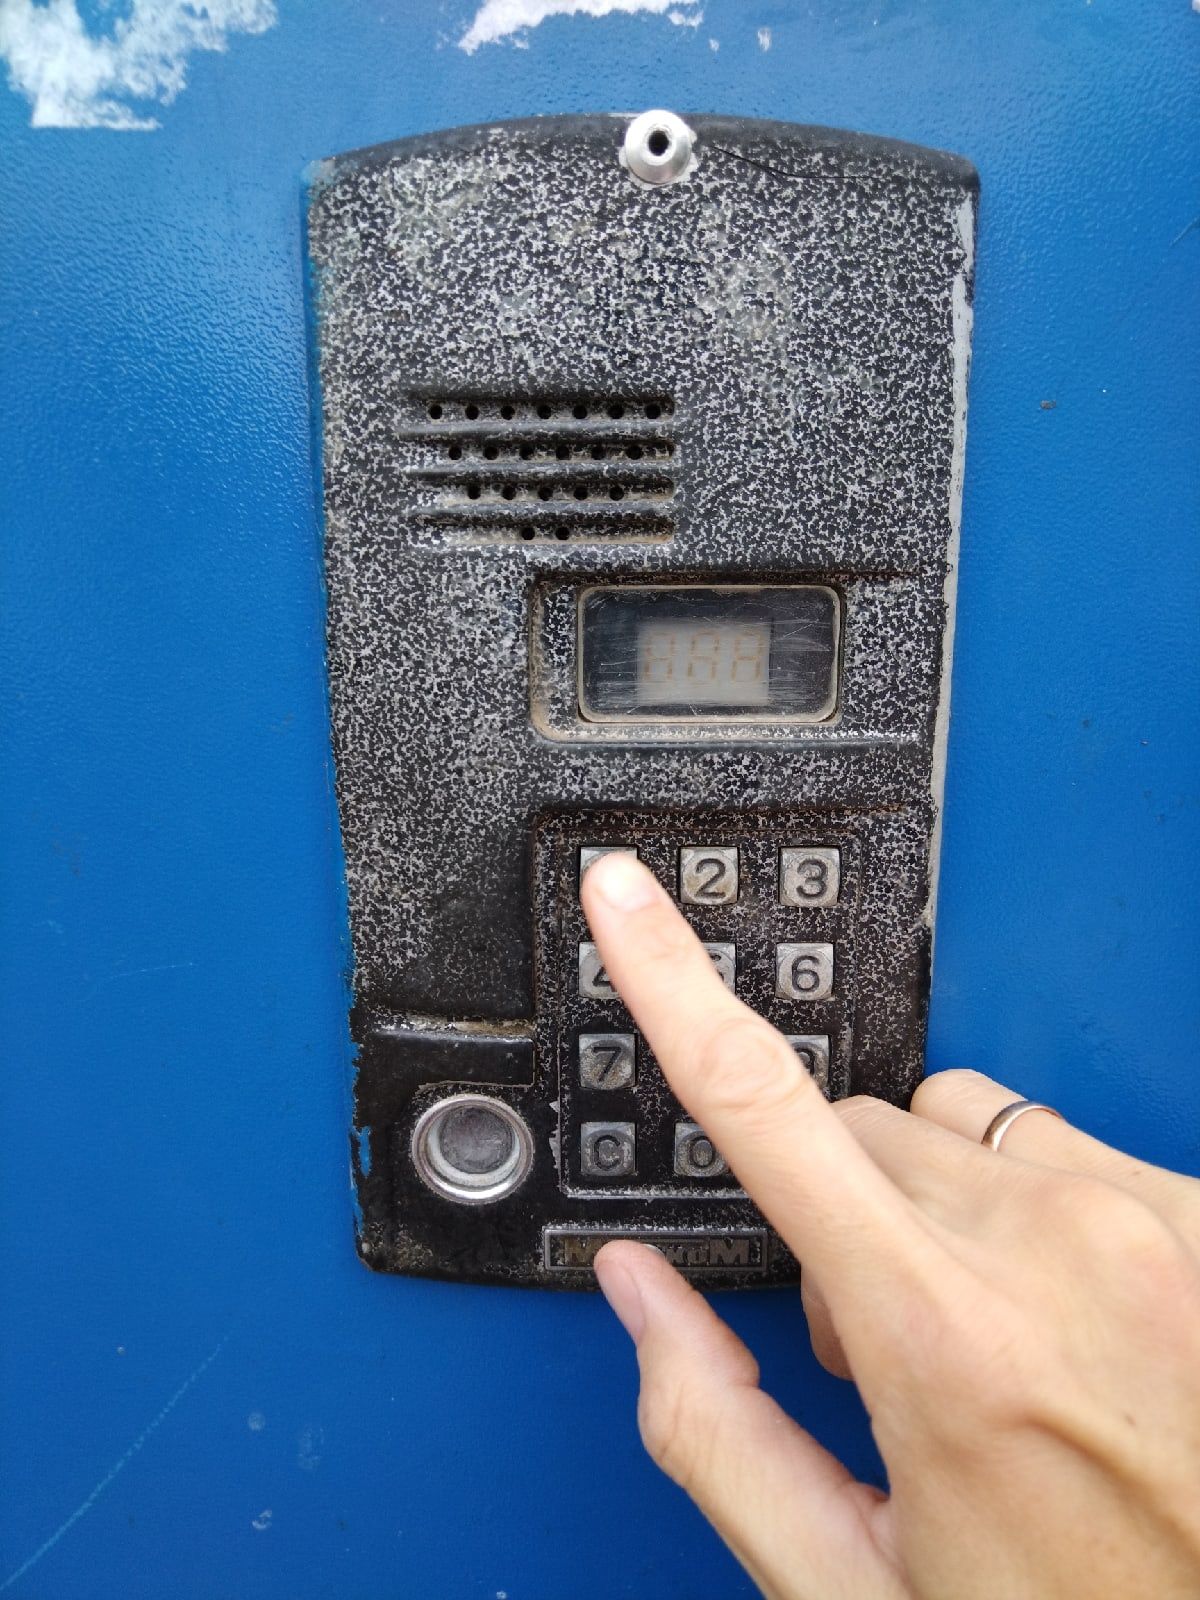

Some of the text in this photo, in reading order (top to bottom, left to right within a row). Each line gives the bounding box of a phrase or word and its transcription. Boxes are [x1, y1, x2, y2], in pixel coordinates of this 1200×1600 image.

[694, 857, 726, 899] 2
[795, 857, 828, 899] 3
[790, 954, 821, 993] 6
[593, 1046, 622, 1083] 7
